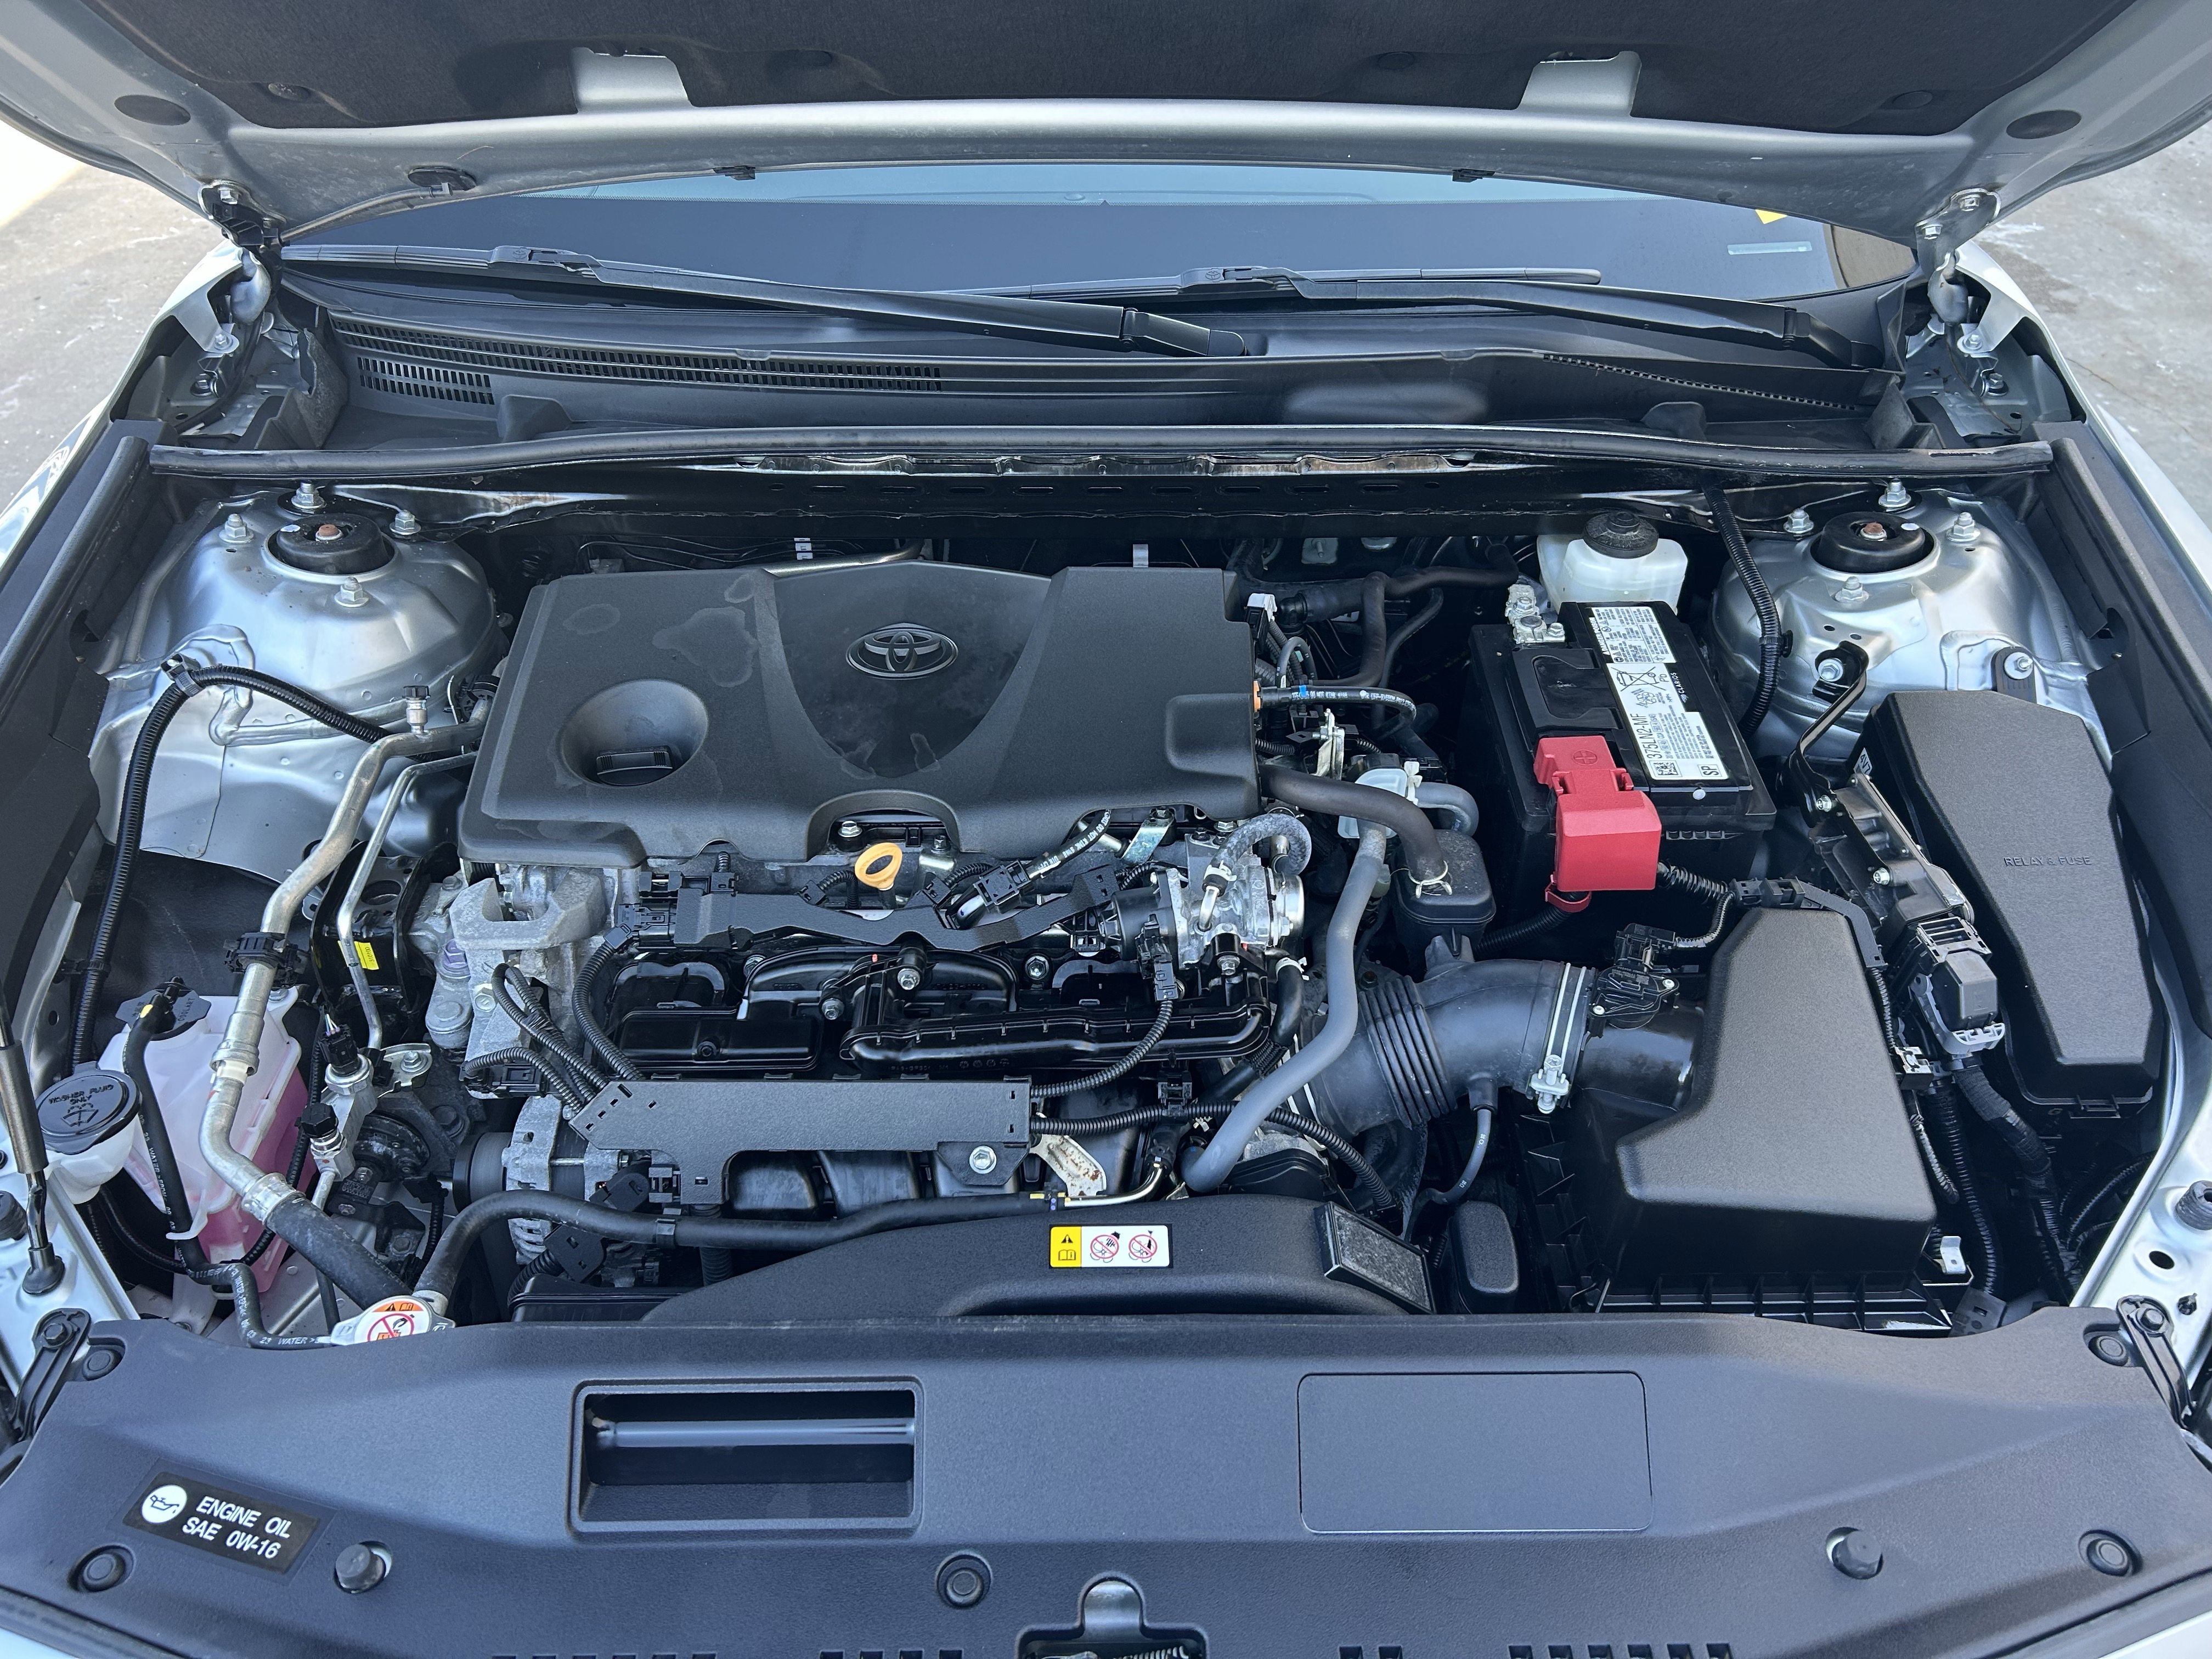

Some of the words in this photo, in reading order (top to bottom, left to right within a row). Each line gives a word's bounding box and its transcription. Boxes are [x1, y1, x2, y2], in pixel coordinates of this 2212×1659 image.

[1671, 673, 1685, 693] CLARIOS
[1630, 713, 1662, 759] 375LN2-MF
[1701, 766, 1719, 775] SP
[2004, 857, 2043, 866] RELAY
[2047, 857, 2056, 866] &
[2059, 856, 2093, 865] FUSE
[178, 997, 196, 1022] COOLANT
[70, 1094, 92, 1105] ONLY
[196, 1496, 262, 1528] ENGINE
[264, 1516, 292, 1539] OIL
[182, 1516, 222, 1541] SAE
[225, 1530, 281, 1559] 0W-16
